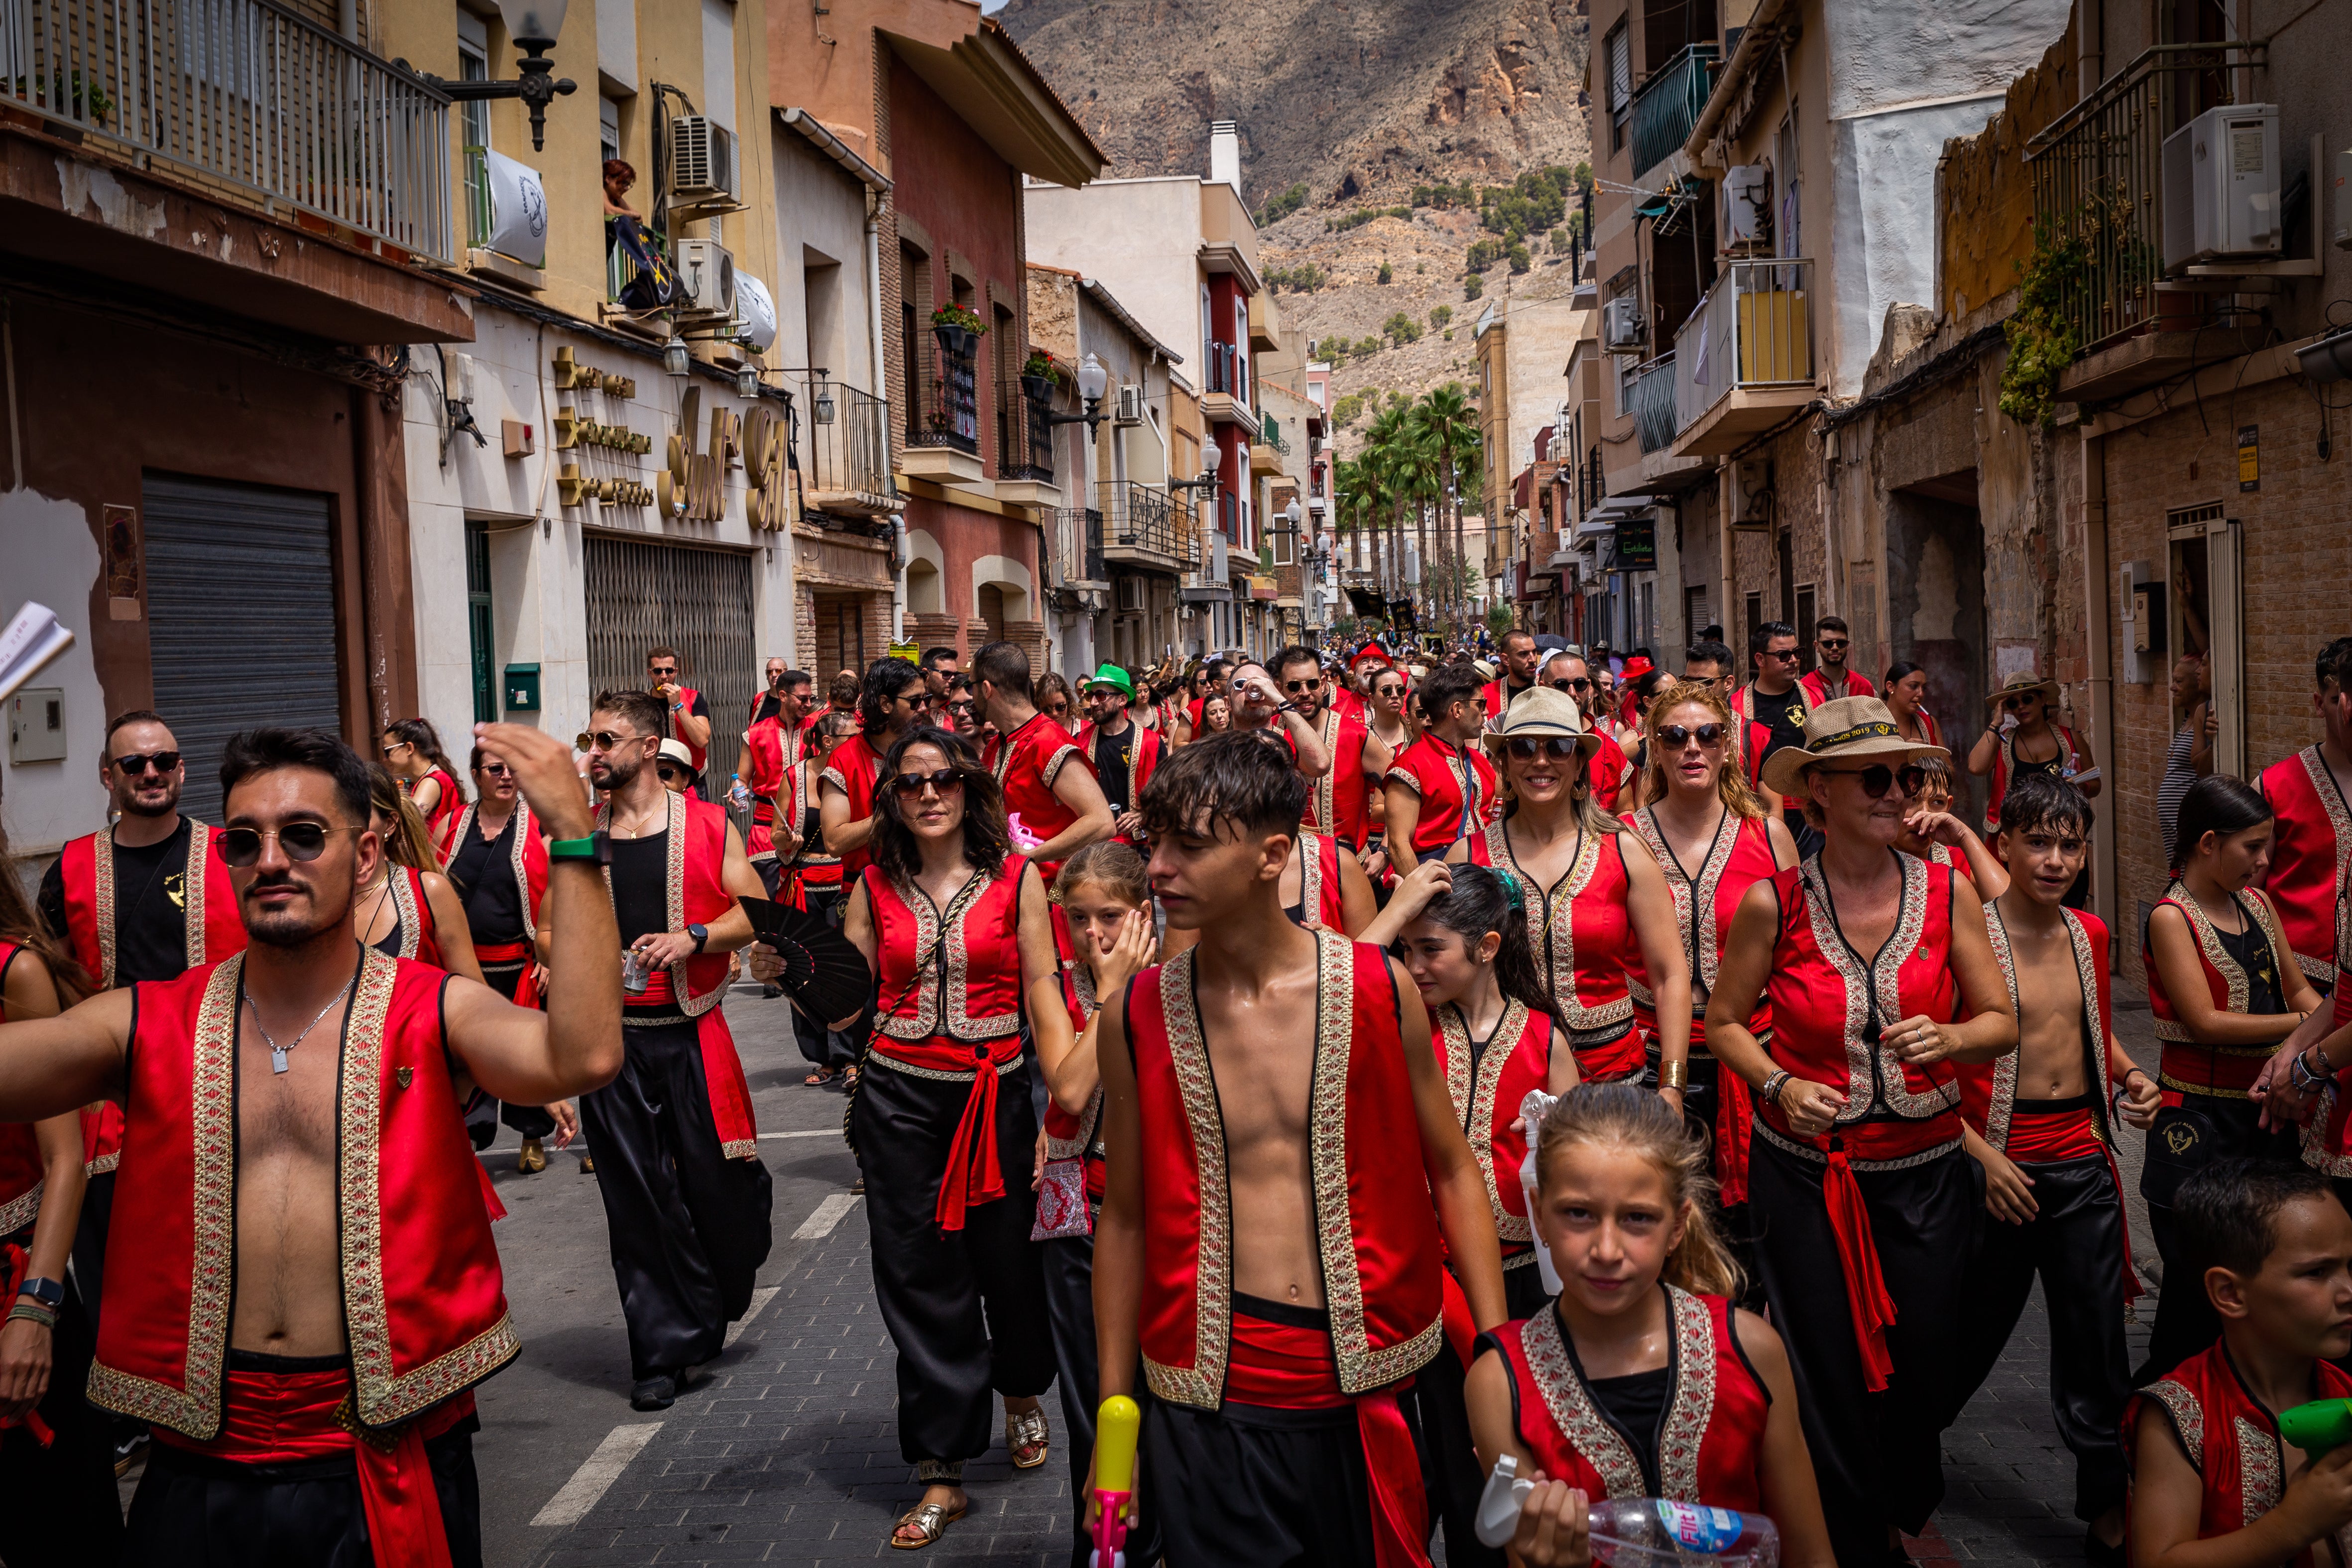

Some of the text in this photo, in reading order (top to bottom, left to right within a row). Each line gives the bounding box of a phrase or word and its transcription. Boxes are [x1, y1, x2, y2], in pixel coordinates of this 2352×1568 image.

[1623, 542, 1652, 554] Estilista
[1852, 727, 1870, 737] 2019
[2162, 1122, 2177, 1135] MOROS
[2183, 1122, 2199, 1143] ALHAMED
[1680, 1514, 1700, 1546] Flit
